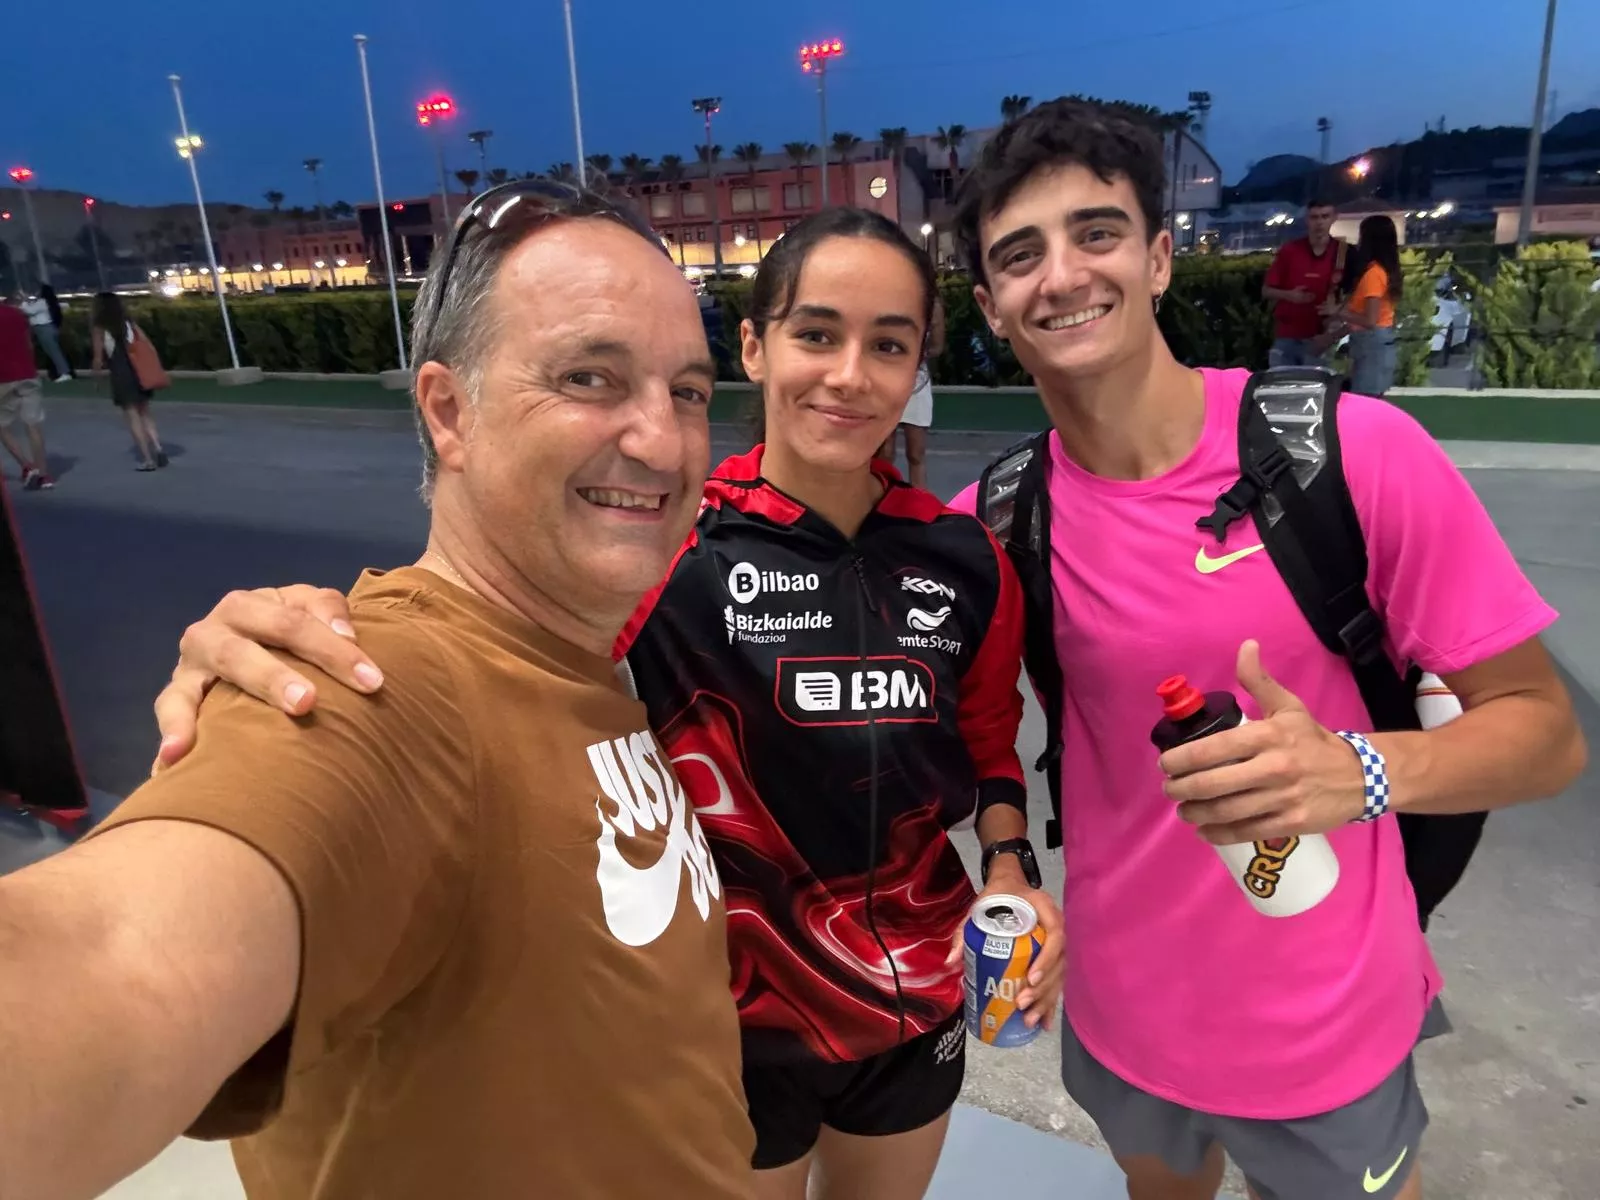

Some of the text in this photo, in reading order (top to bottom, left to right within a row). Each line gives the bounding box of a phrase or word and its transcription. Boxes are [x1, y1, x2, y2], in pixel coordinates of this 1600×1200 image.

[736, 571, 820, 594] Bilbao
[736, 611, 833, 632] Bizkaialde
[738, 630, 787, 644] fundazioa
